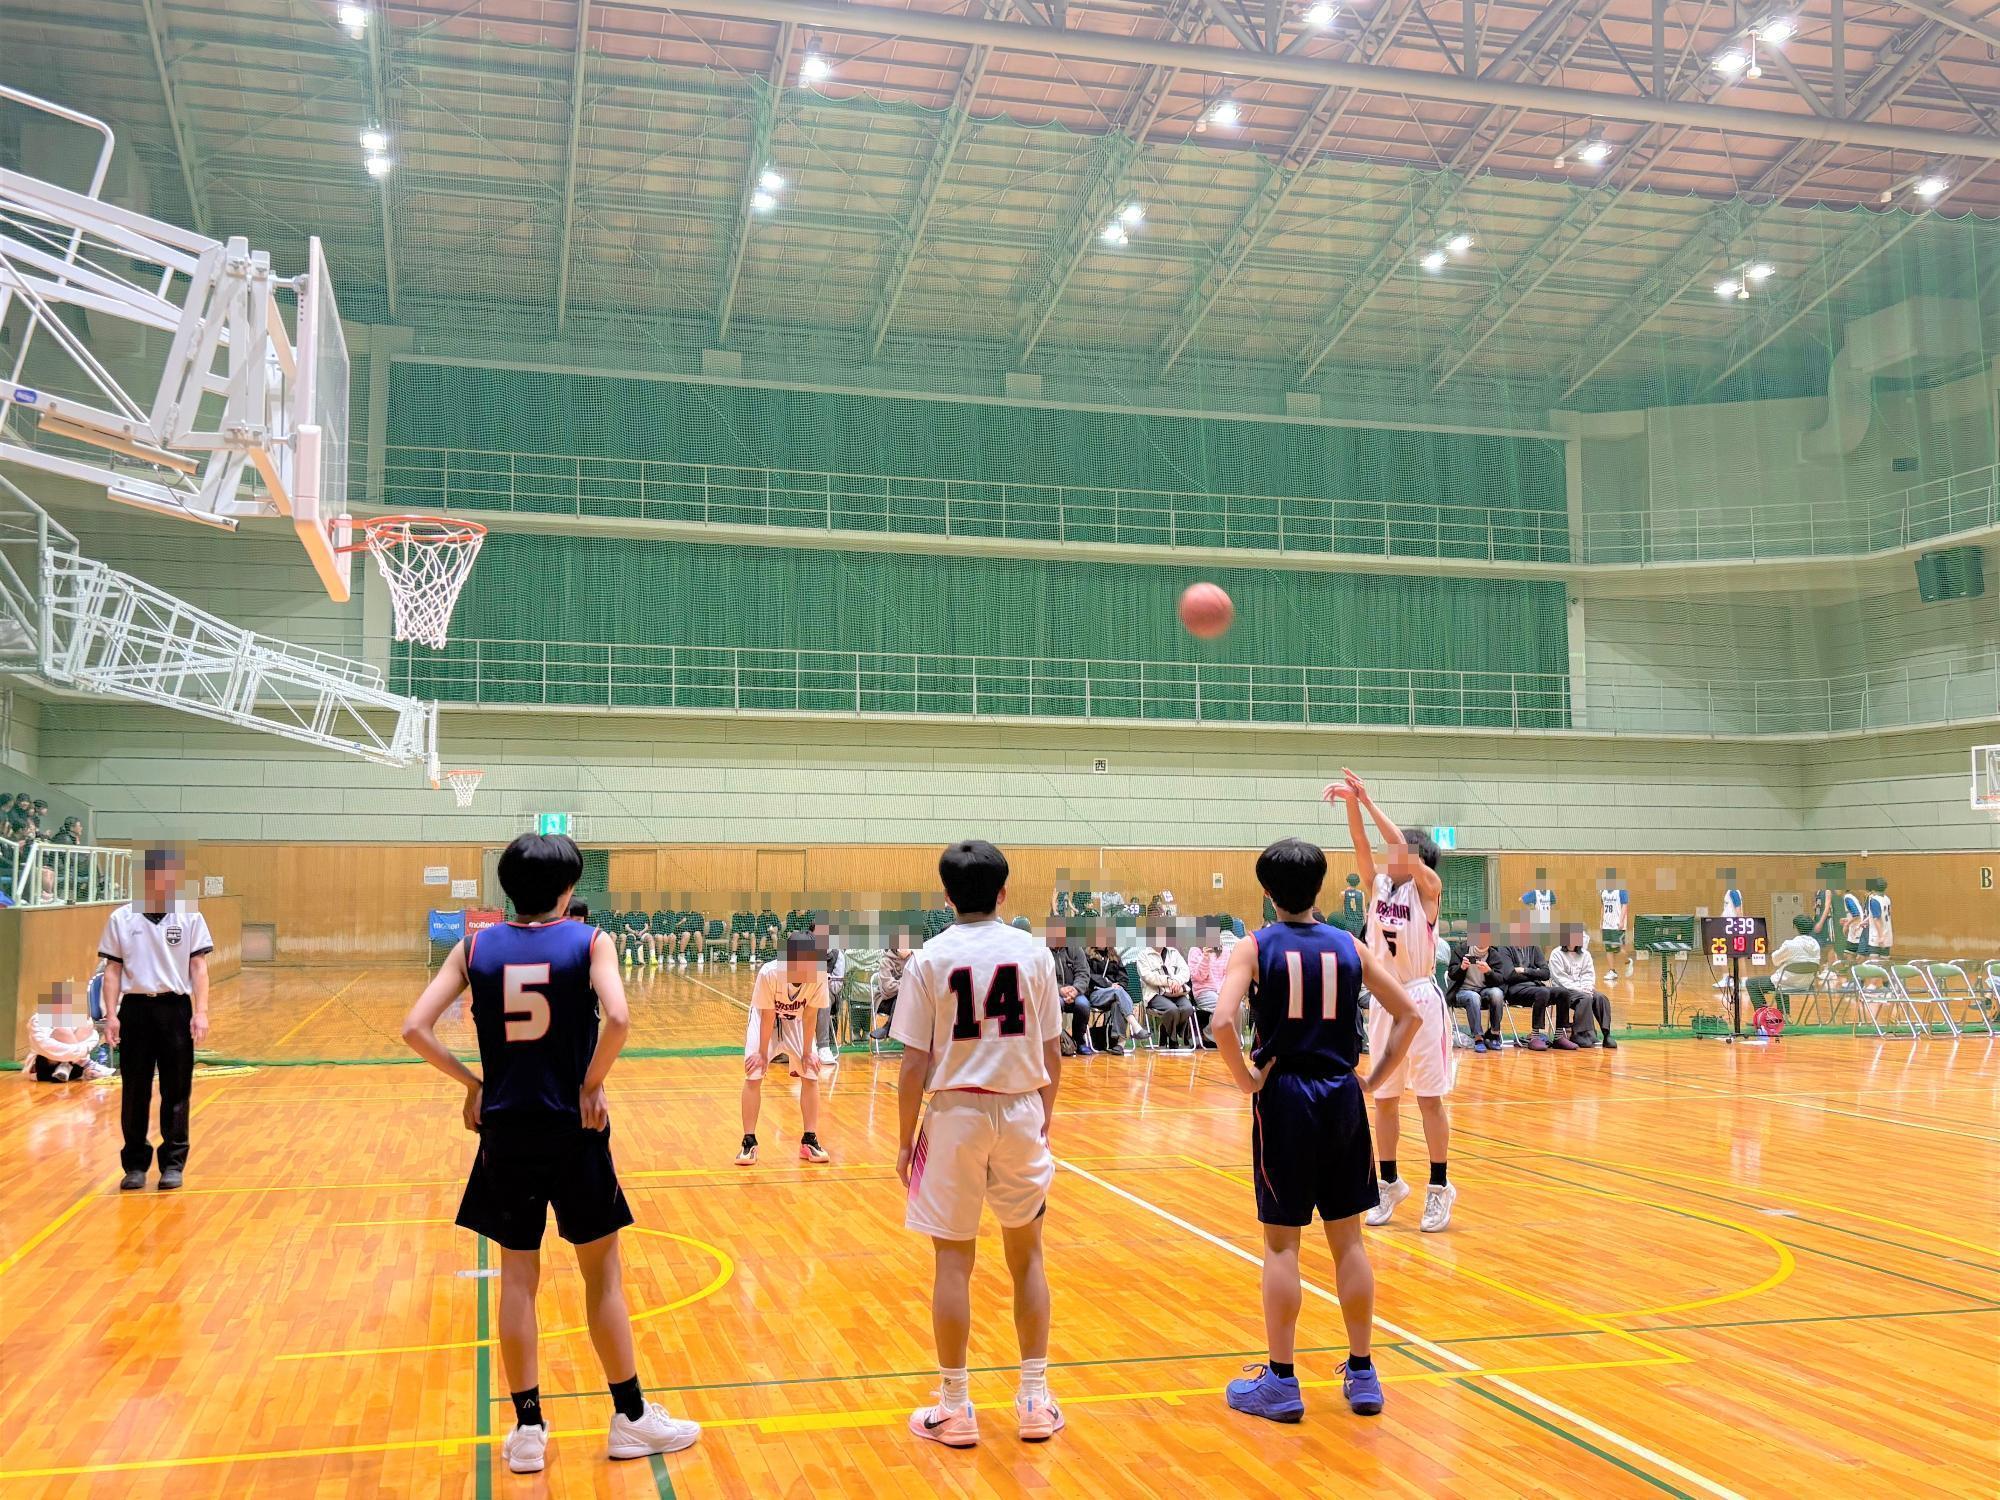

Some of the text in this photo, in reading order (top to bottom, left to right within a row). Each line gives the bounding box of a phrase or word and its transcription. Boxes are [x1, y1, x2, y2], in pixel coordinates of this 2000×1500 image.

[1095, 760, 1106, 771] 西
[1982, 868, 1992, 888] B
[468, 921, 495, 929] molten
[1726, 918, 1754, 934] 2:39
[1711, 938, 1727, 954] 25
[1733, 936, 1746, 952] 19
[1754, 938, 1766, 954] 15
[1285, 951, 1338, 1020] 11
[503, 963, 551, 1042] 5
[948, 963, 1025, 1041] 14
